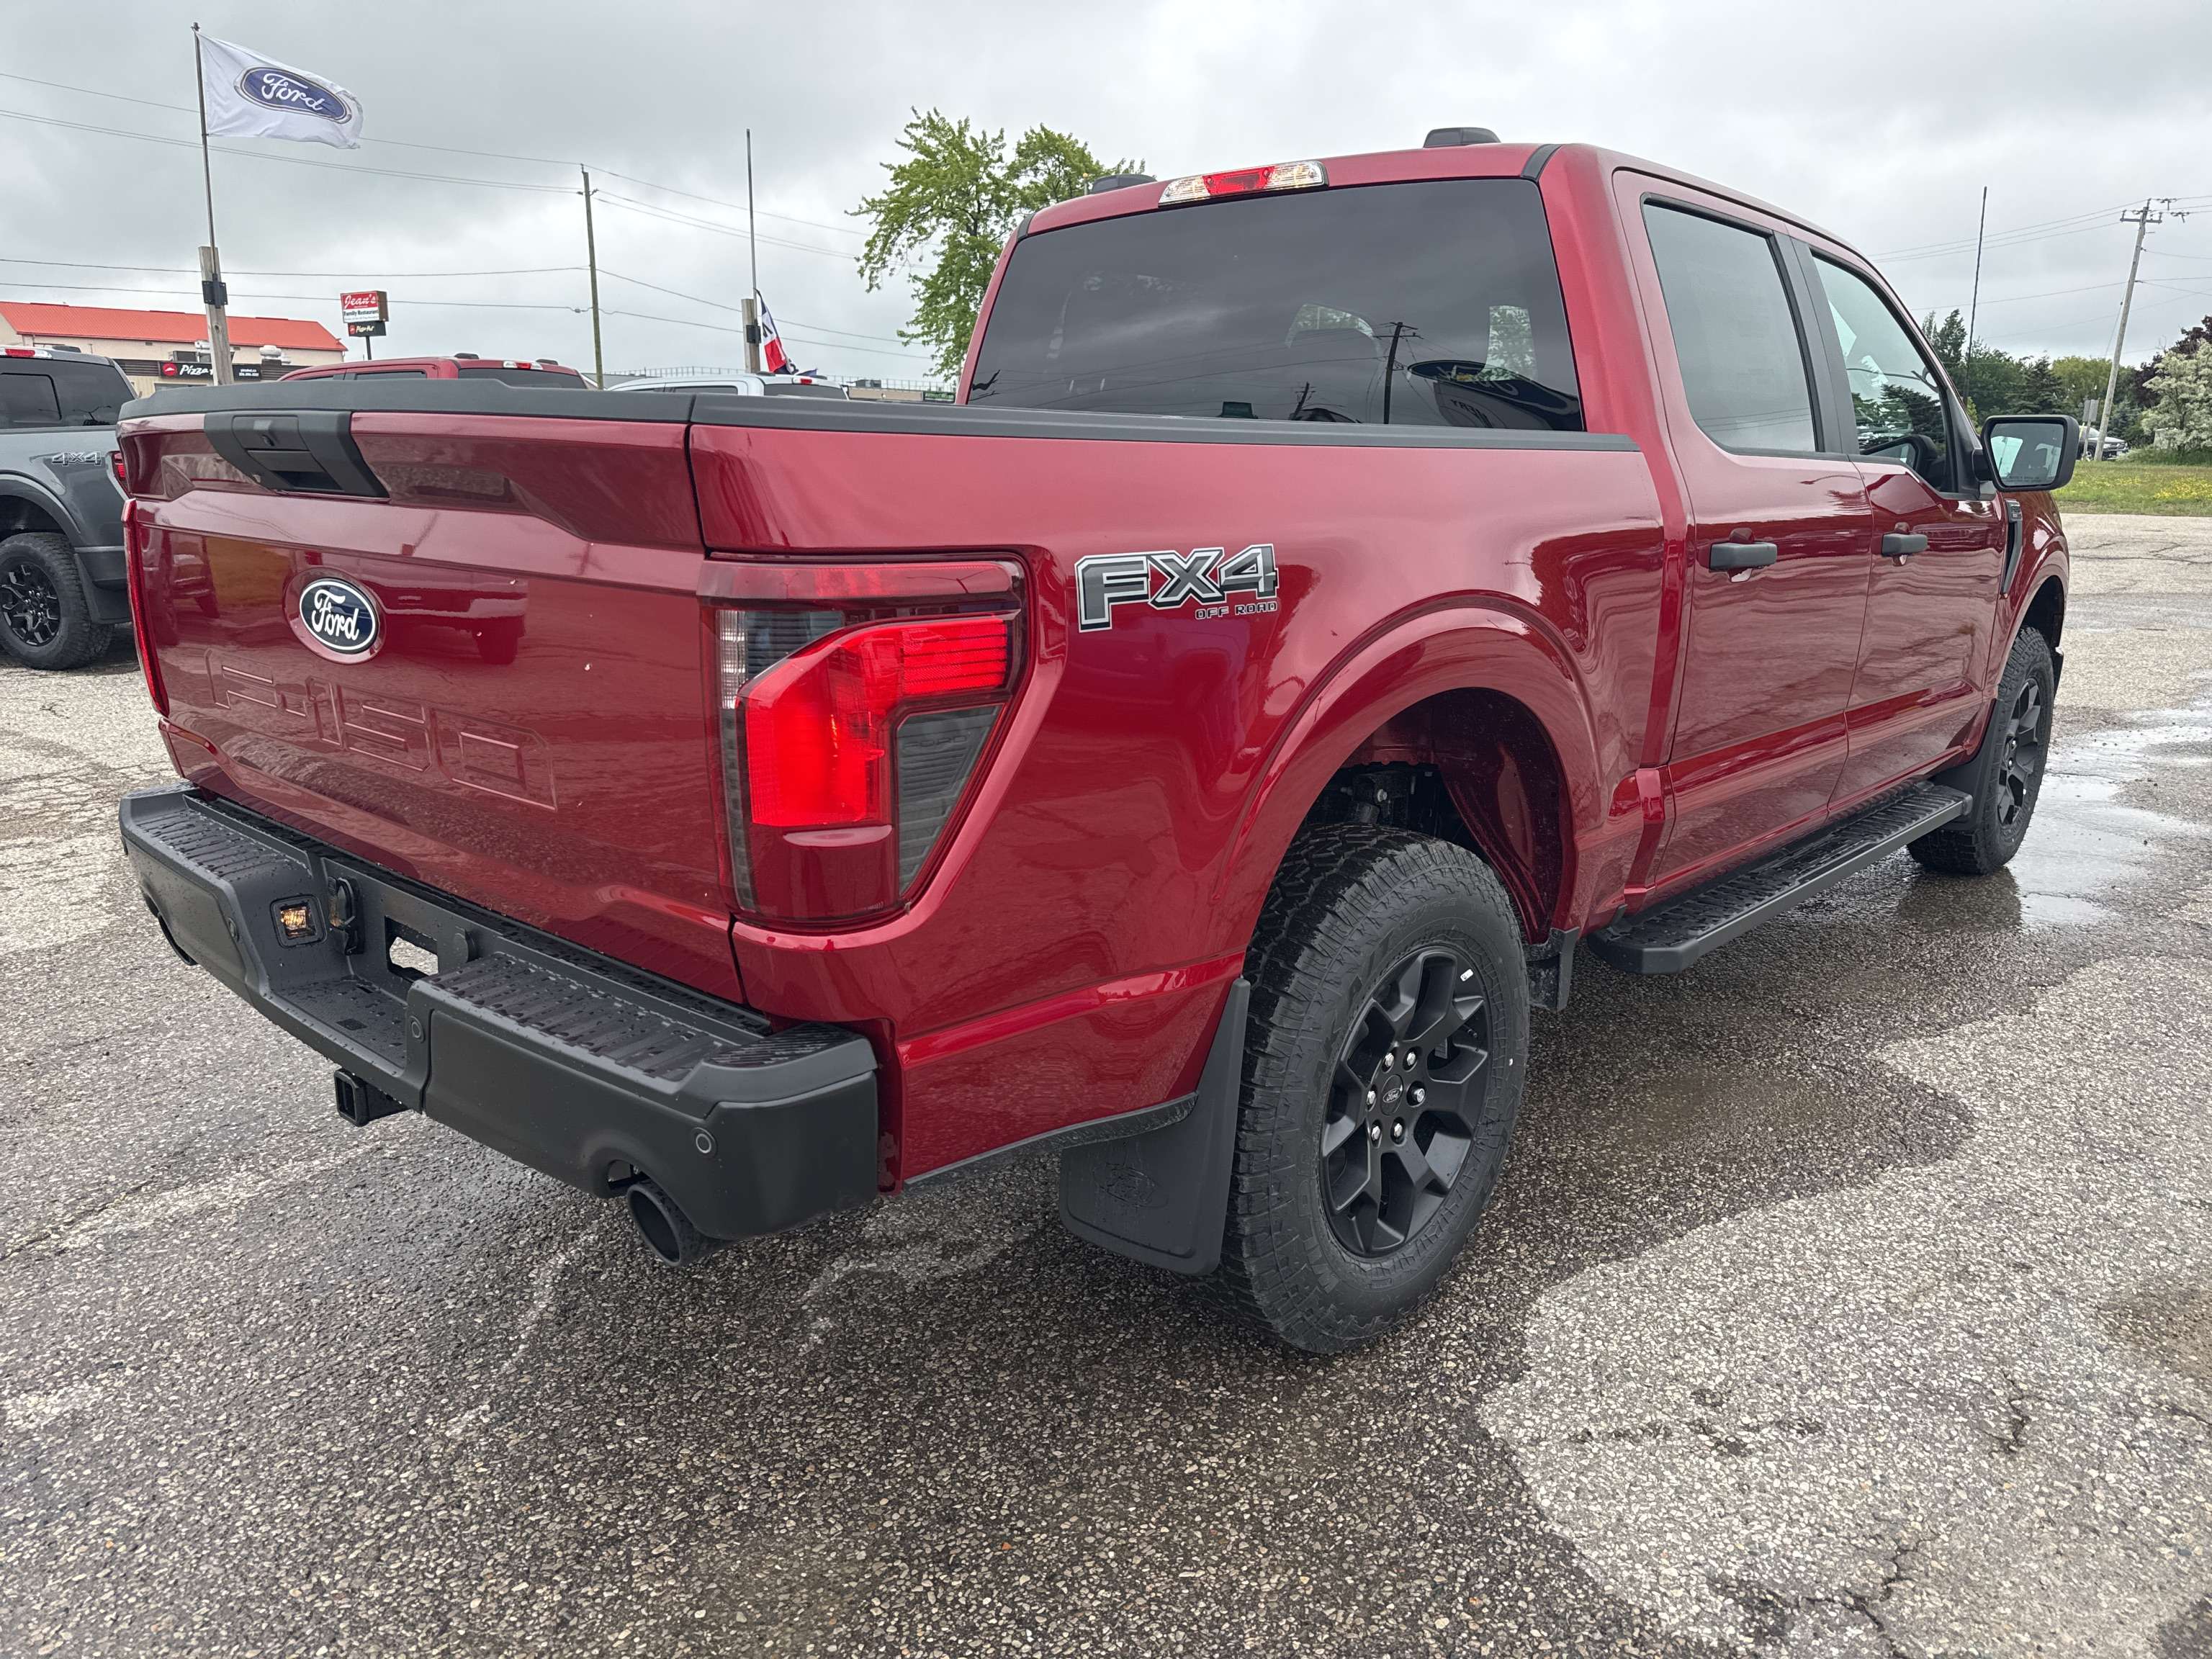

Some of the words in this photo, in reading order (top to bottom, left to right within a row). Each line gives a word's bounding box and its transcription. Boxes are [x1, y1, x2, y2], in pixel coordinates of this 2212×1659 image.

[261, 73, 325, 111] Ford
[344, 294, 377, 309] Jean's
[179, 364, 209, 376] Pizza
[1074, 543, 1280, 633] FX4
[311, 589, 359, 641] Ford
[1195, 606, 1229, 620] OFF
[1234, 601, 1278, 616] ROAD
